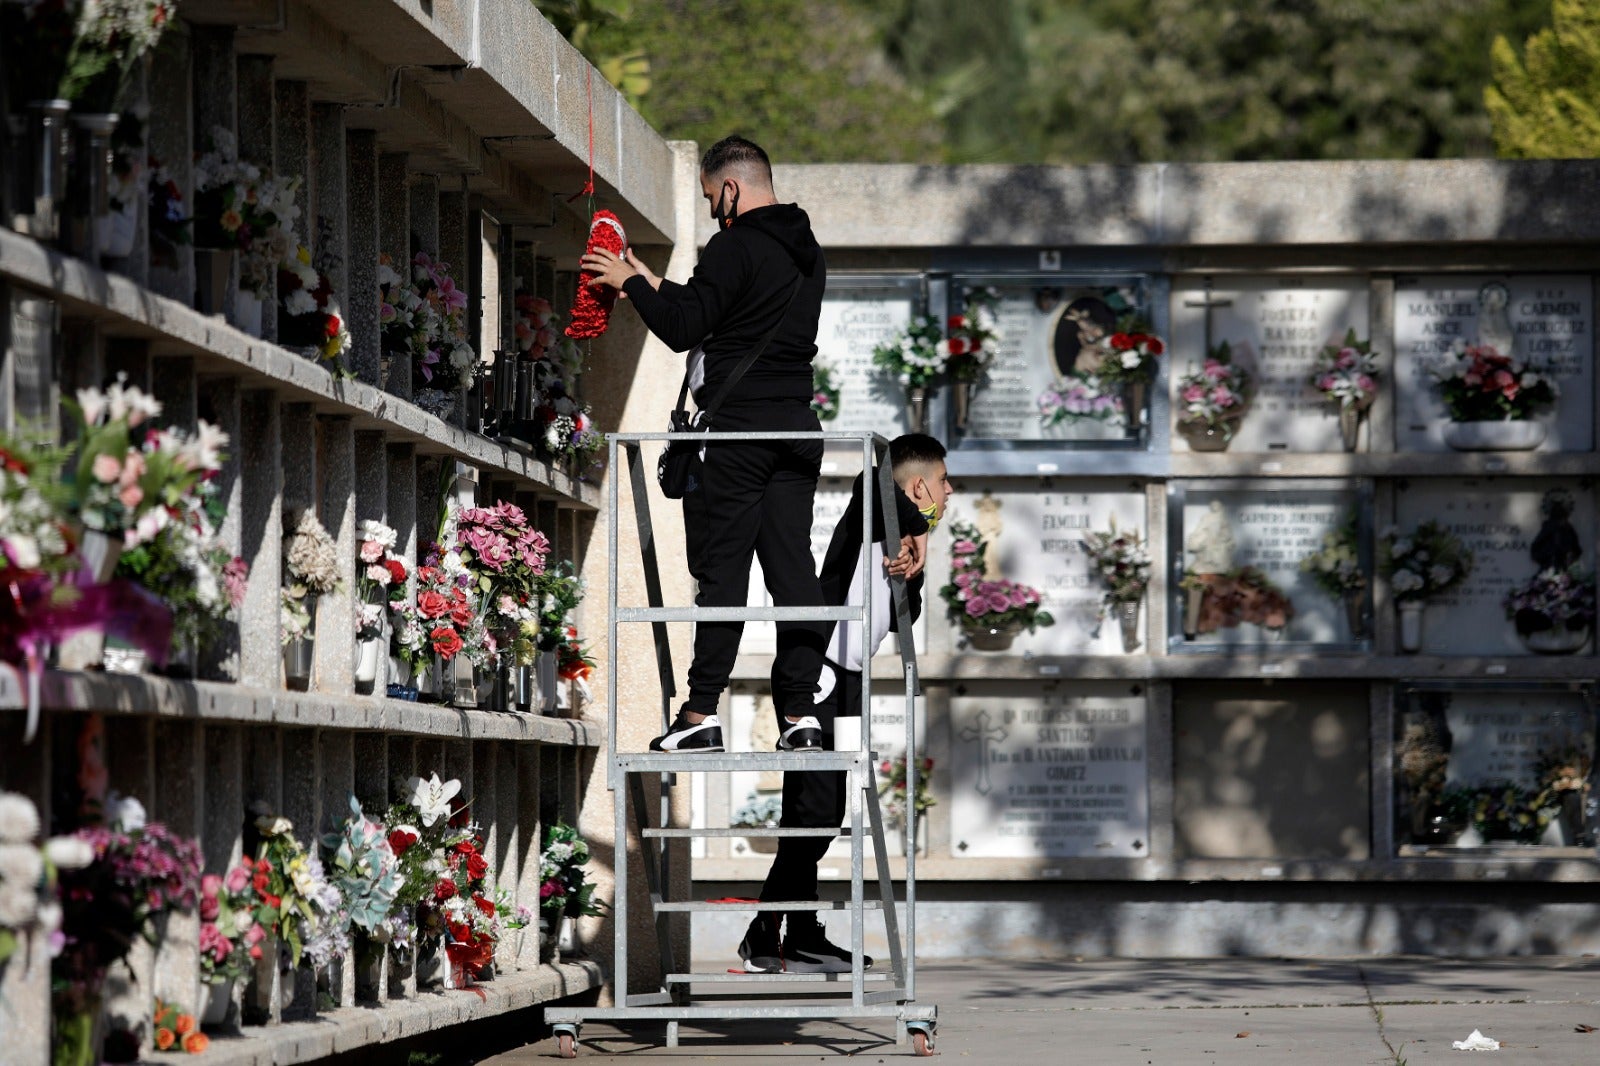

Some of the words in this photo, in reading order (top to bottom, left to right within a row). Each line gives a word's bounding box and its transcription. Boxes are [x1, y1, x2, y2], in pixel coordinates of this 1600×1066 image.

[1260, 308, 1318, 322] JOSEFA
[1408, 303, 1475, 317] MANUEL
[1519, 302, 1581, 316] CARMEN
[1264, 327, 1318, 340] RAMOS
[1037, 729, 1096, 743] SANTIAGO
